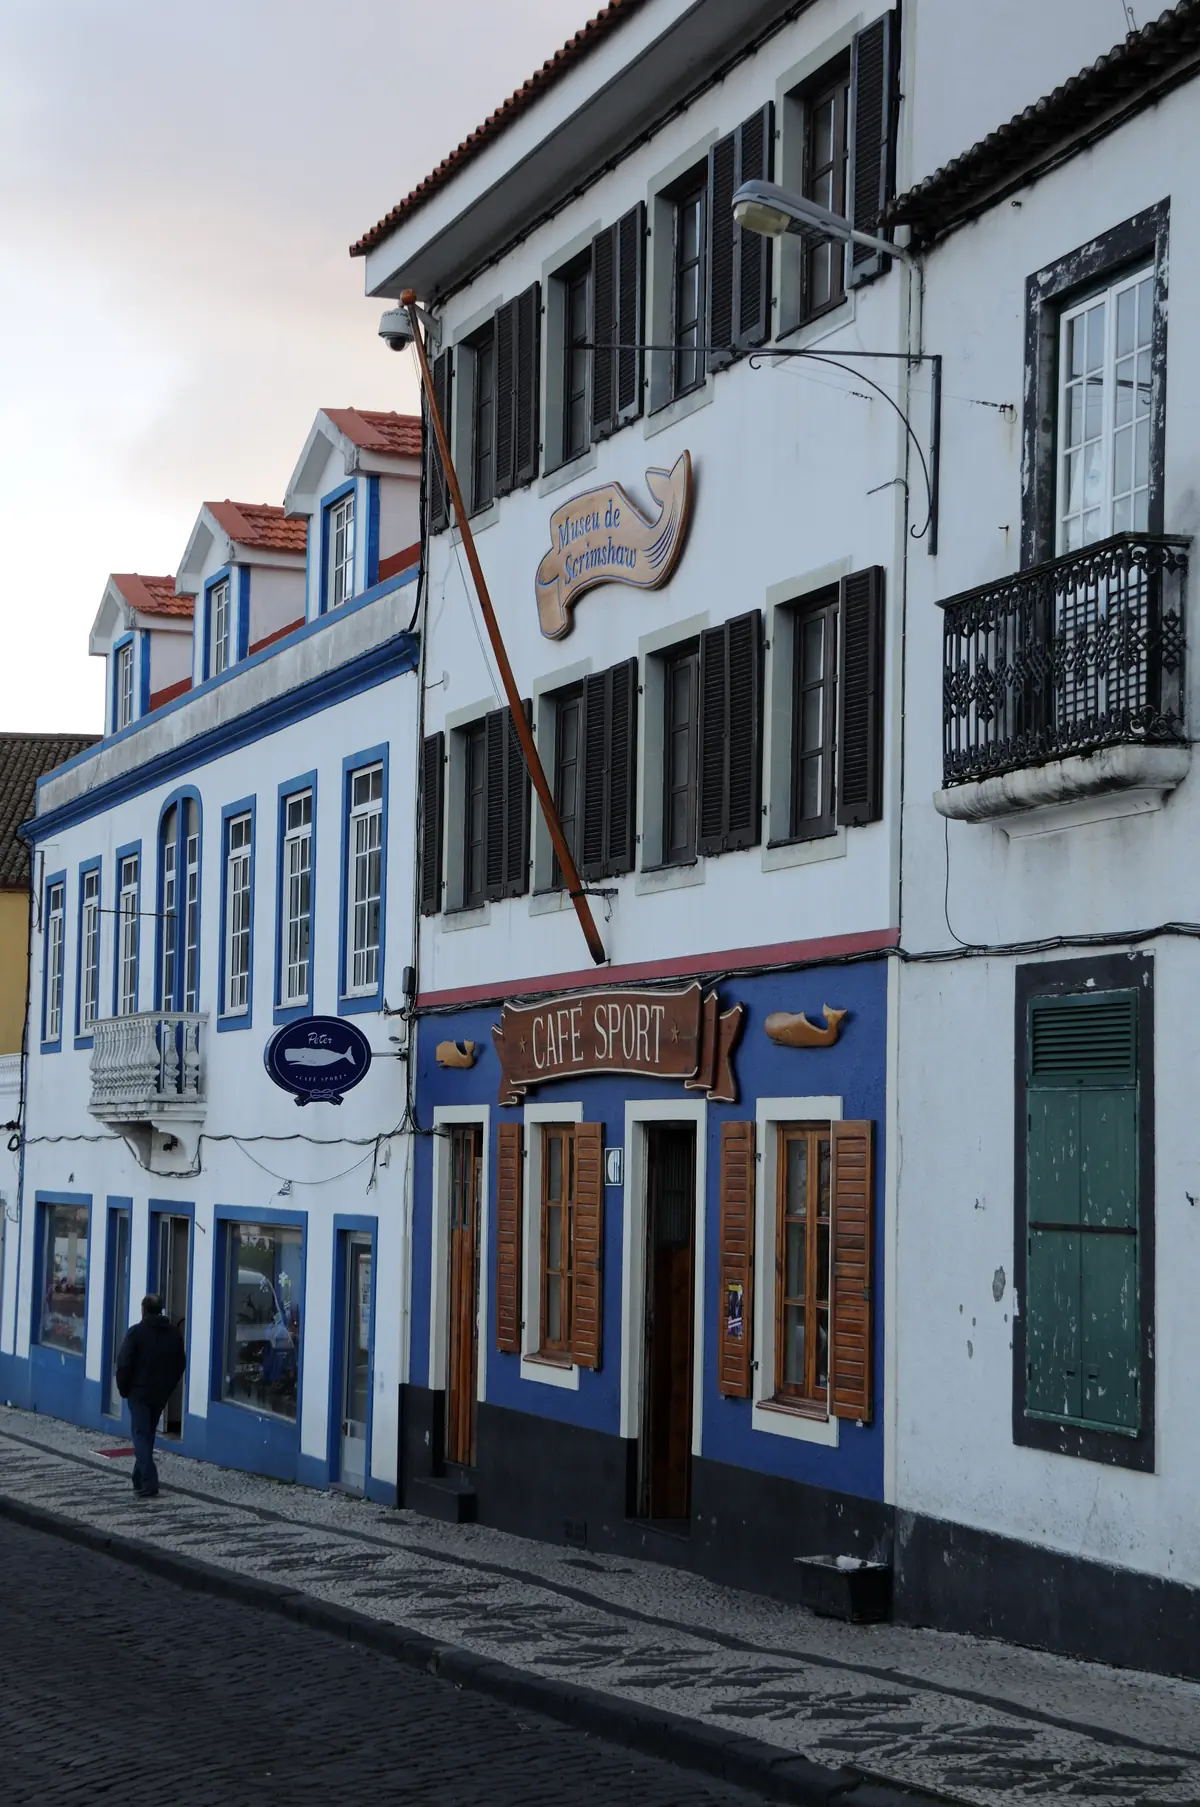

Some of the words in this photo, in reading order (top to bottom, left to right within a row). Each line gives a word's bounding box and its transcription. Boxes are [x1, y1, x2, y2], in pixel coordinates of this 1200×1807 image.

[557, 511, 601, 555] Museu
[604, 498, 620, 529] de
[564, 536, 637, 586] Scrimshaw
[308, 1032, 332, 1044] Peter
[532, 1000, 584, 1069] CAFÉ
[594, 1003, 665, 1063] SPORT
